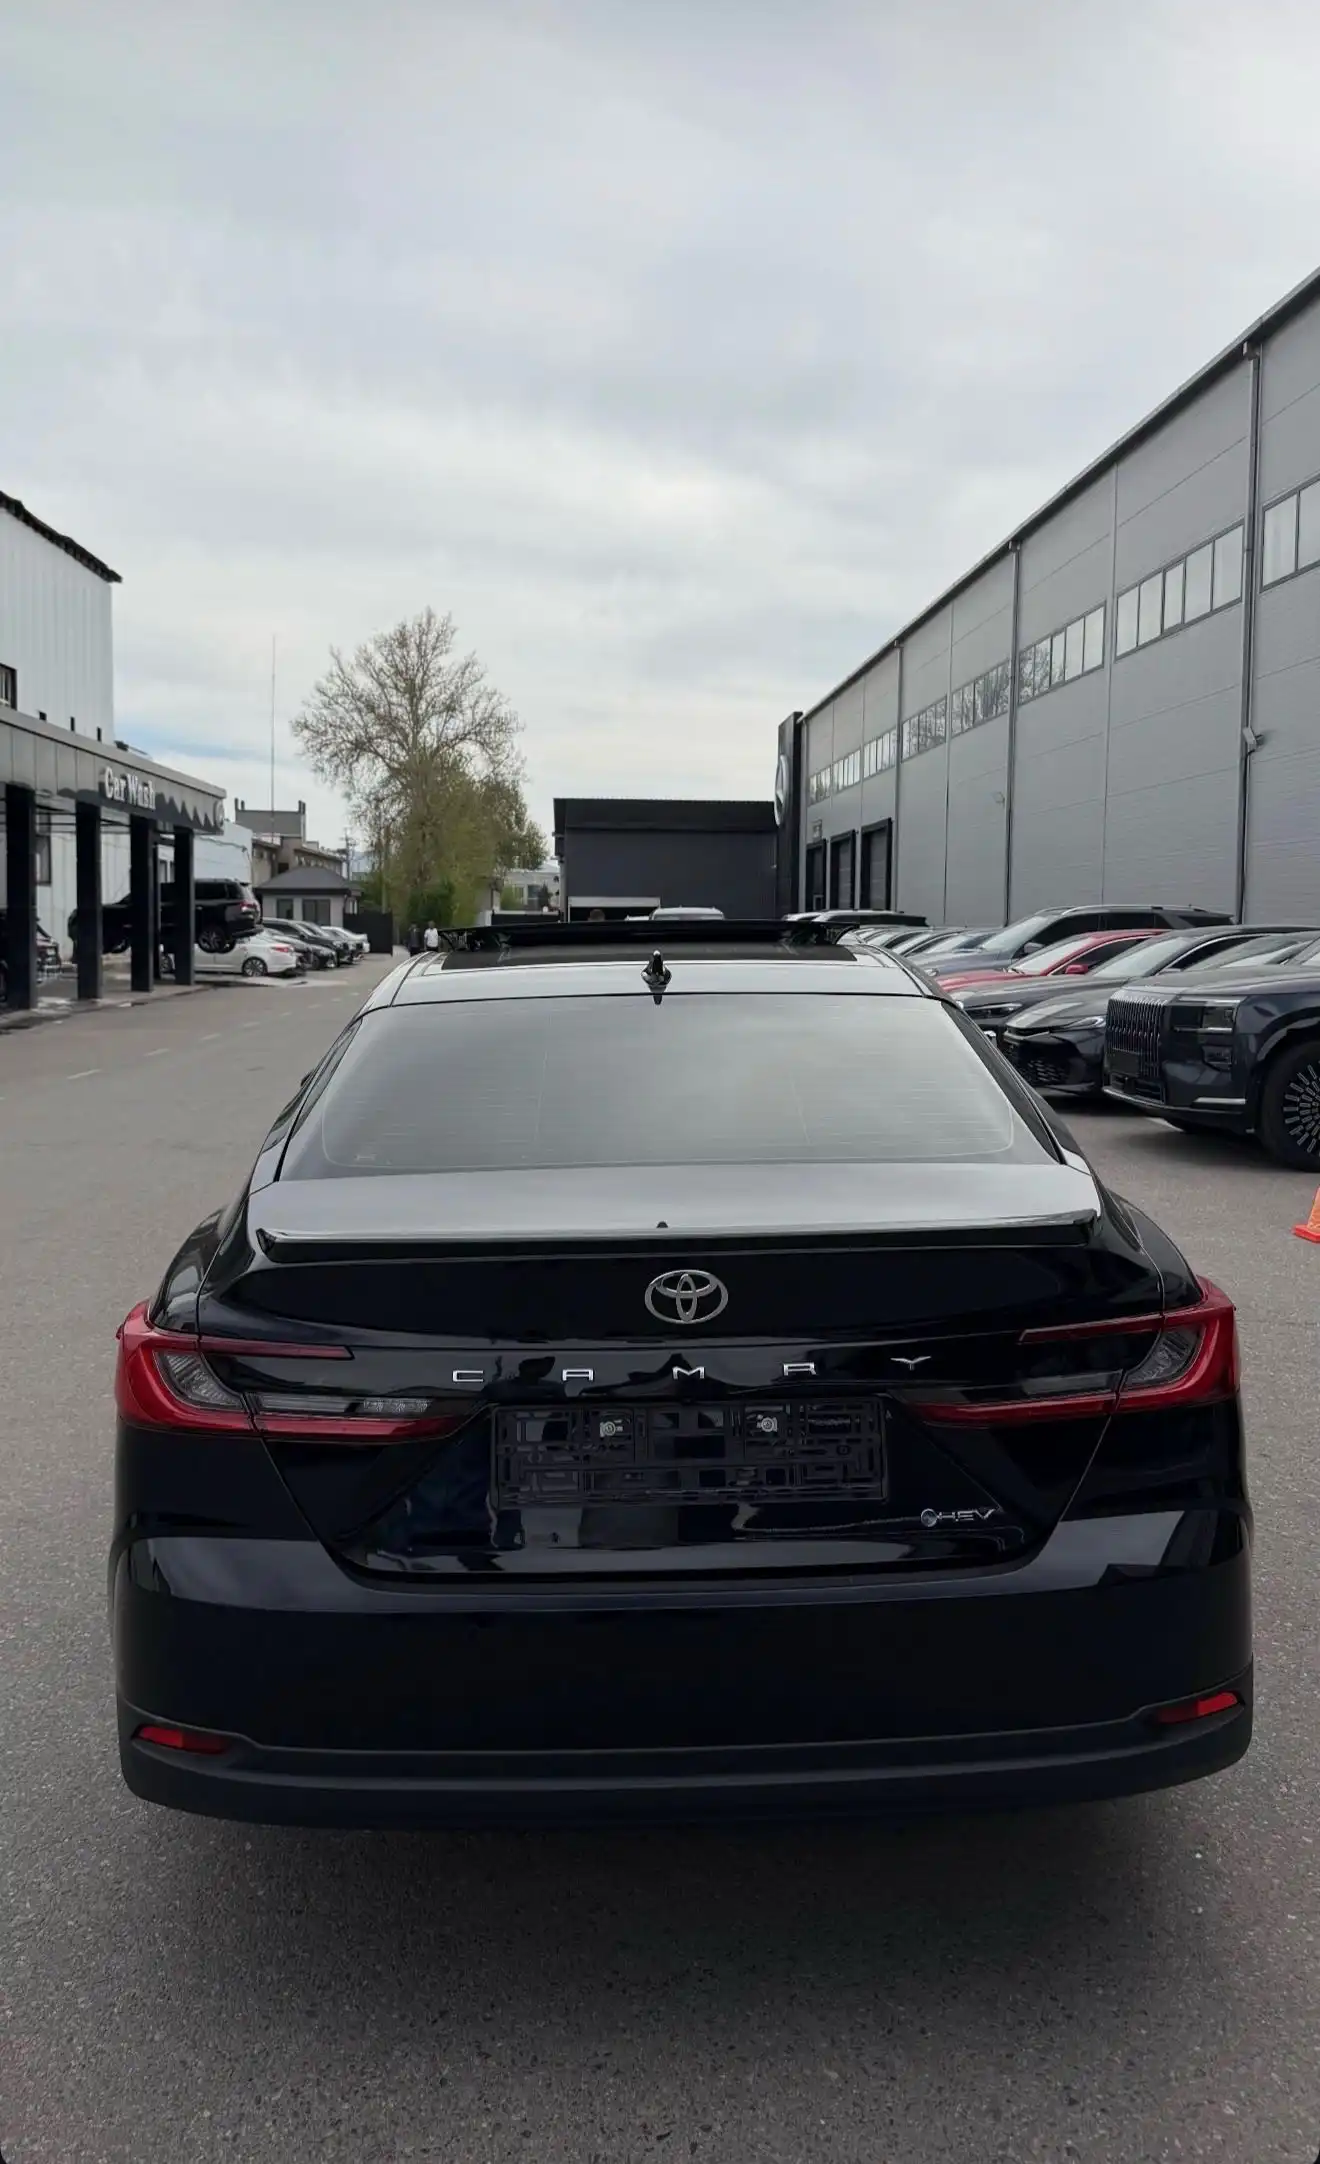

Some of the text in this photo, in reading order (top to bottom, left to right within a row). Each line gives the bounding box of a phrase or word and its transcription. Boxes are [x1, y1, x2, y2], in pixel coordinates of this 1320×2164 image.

[104, 766, 156, 811] Car Wash
[452, 1355, 932, 1383] CAMRY
[938, 1508, 996, 1522] HEV
